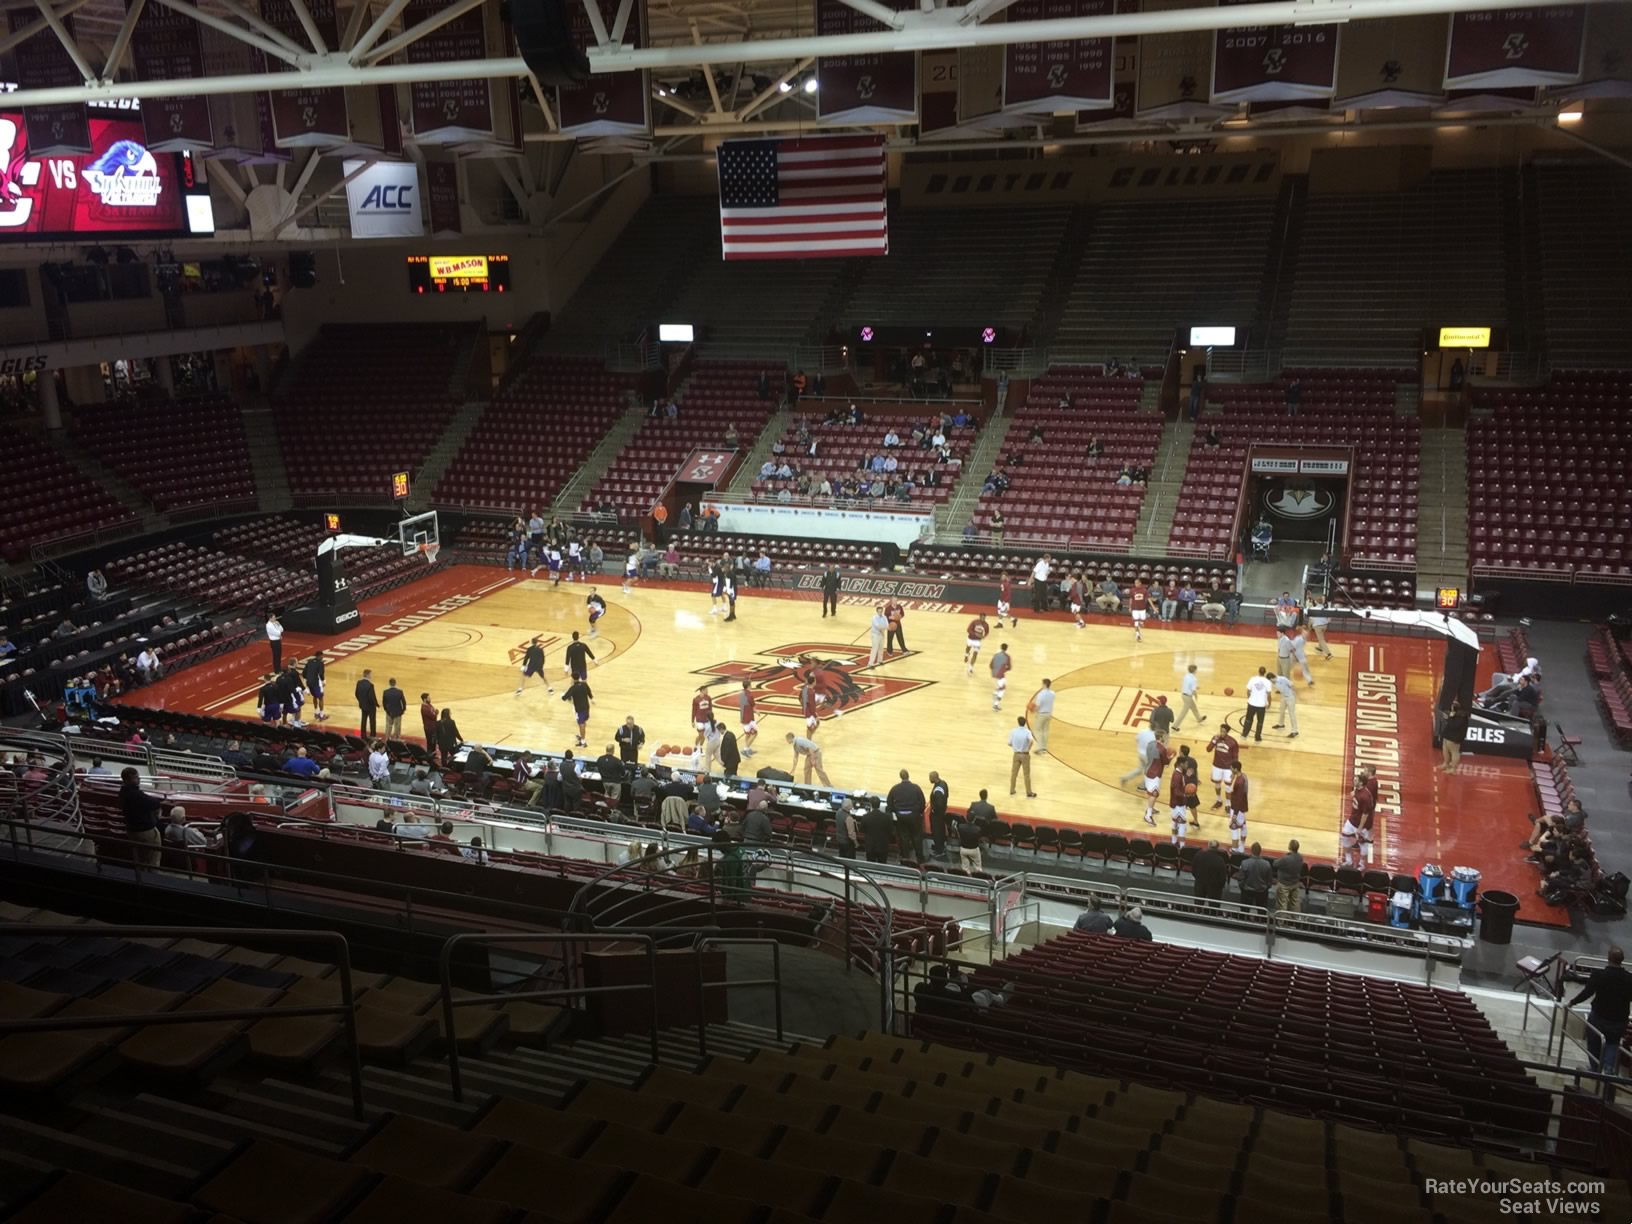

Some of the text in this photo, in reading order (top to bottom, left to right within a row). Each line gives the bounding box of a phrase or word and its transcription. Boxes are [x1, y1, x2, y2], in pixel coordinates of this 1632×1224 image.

[1225, 32, 1326, 48] 2007 2016
[1015, 65, 1037, 73] 1963
[50, 160, 77, 190] VS
[924, 172, 1073, 195] BOSTON
[361, 184, 413, 209] ACC
[395, 482, 408, 497] 30
[798, 574, 946, 599] BCAGLES.COM
[1441, 596, 1454, 606] 30
[336, 609, 359, 624] GEICO
[374, 593, 482, 634] COLLEGE
[1355, 671, 1399, 733] BOSTON
